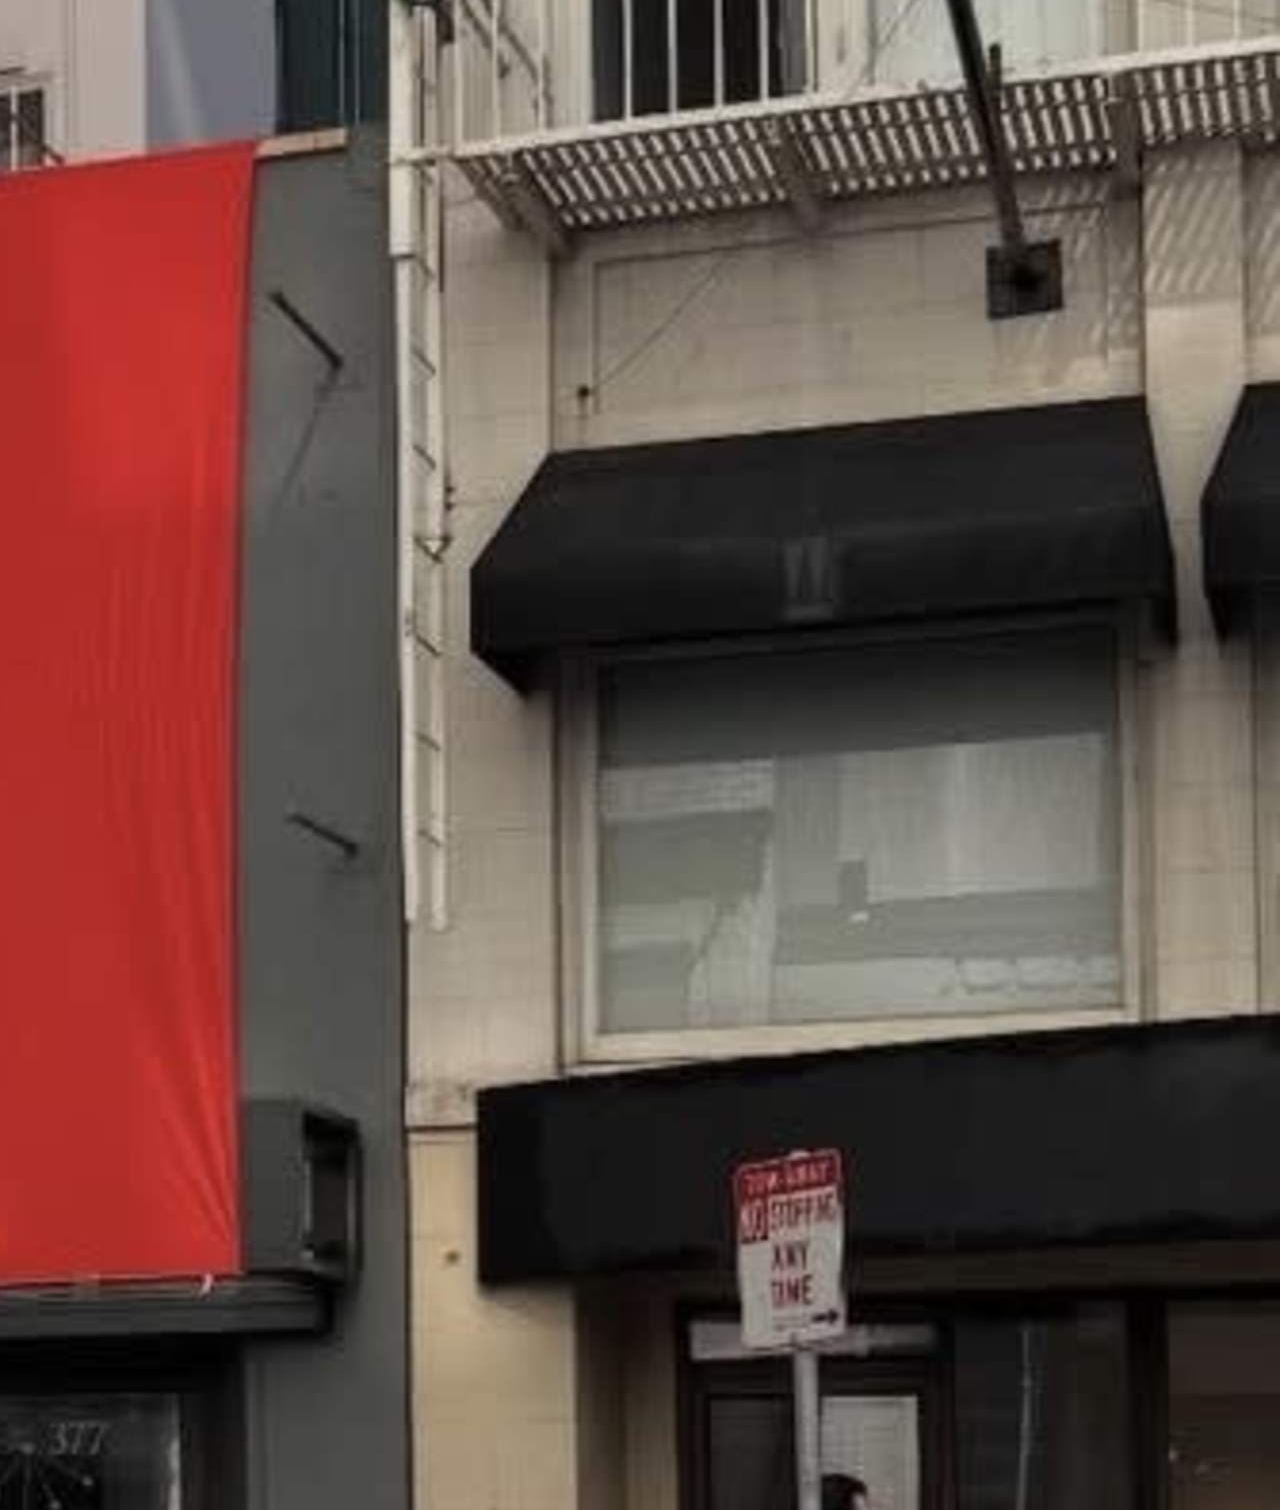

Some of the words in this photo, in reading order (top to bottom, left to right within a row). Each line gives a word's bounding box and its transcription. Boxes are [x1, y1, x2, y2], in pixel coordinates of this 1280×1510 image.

[741, 1200, 768, 1239] NO
[772, 1243, 808, 1271] ANY
[771, 1275, 814, 1308] TIME
[49, 1421, 110, 1456] 377
